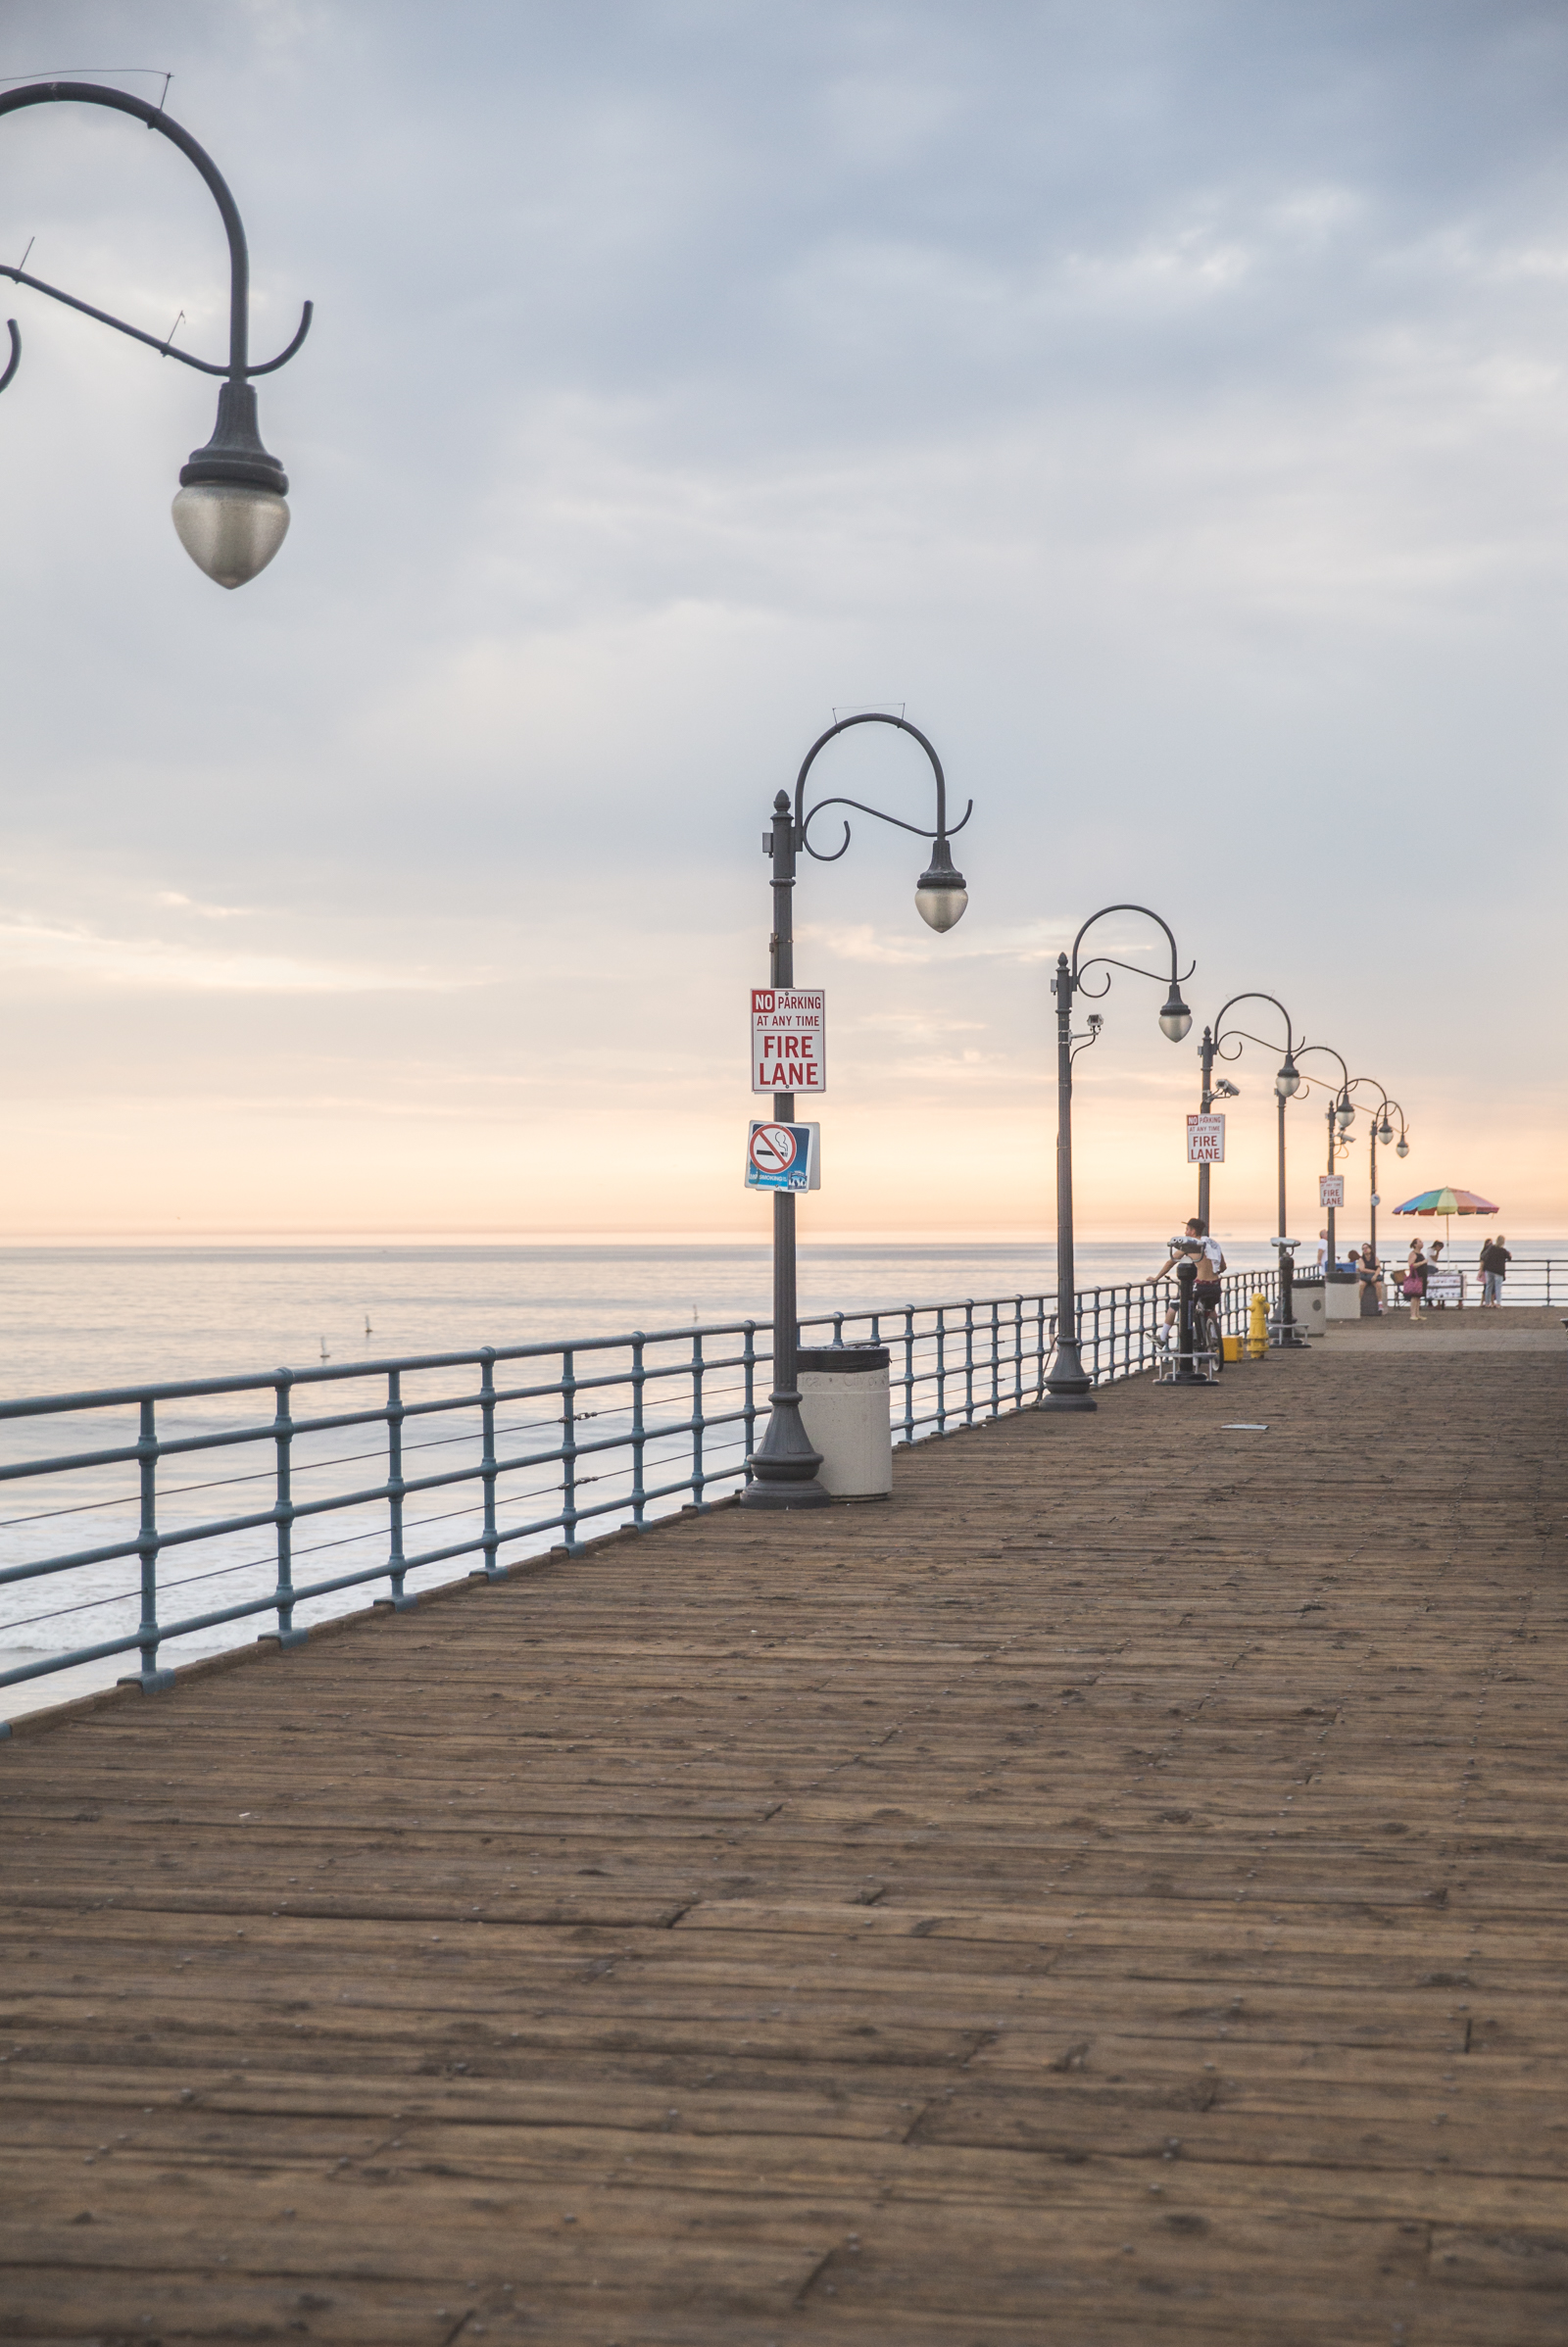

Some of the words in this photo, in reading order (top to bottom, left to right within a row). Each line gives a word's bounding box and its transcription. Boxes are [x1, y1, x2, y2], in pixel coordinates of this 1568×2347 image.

[756, 995, 772, 1010] NO
[778, 997, 821, 1009] PARKING
[757, 1015, 768, 1026] AT
[772, 1015, 792, 1026] ANY
[796, 1015, 819, 1026] TIME
[763, 1036, 813, 1058] FIRE
[760, 1062, 818, 1085] LANE
[1193, 1135, 1217, 1147] FIRE
[1191, 1149, 1220, 1160] LANE
[1322, 1197, 1341, 1205] LANE
